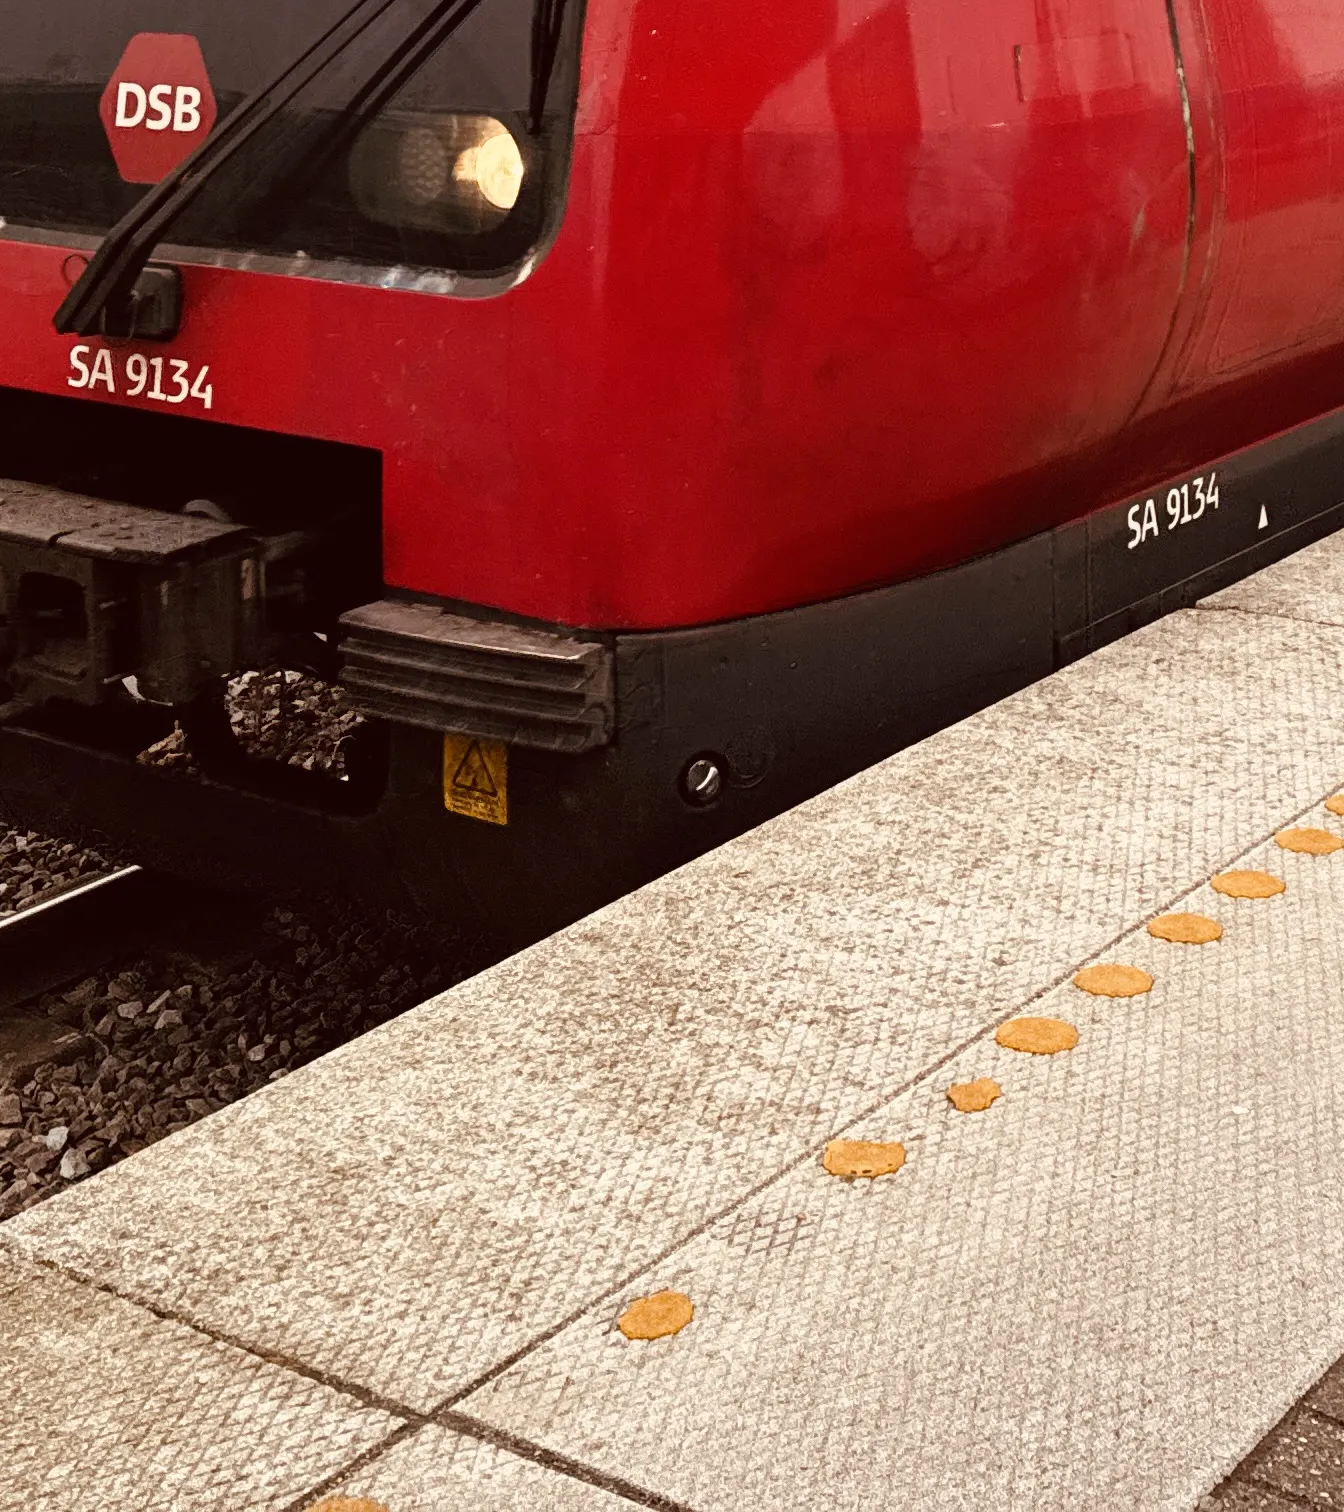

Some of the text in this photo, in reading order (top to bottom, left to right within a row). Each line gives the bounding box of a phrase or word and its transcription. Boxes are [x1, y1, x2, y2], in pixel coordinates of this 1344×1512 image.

[115, 81, 201, 132] DSB
[67, 344, 212, 409] SA 9134
[1127, 471, 1219, 550] SA 9134
